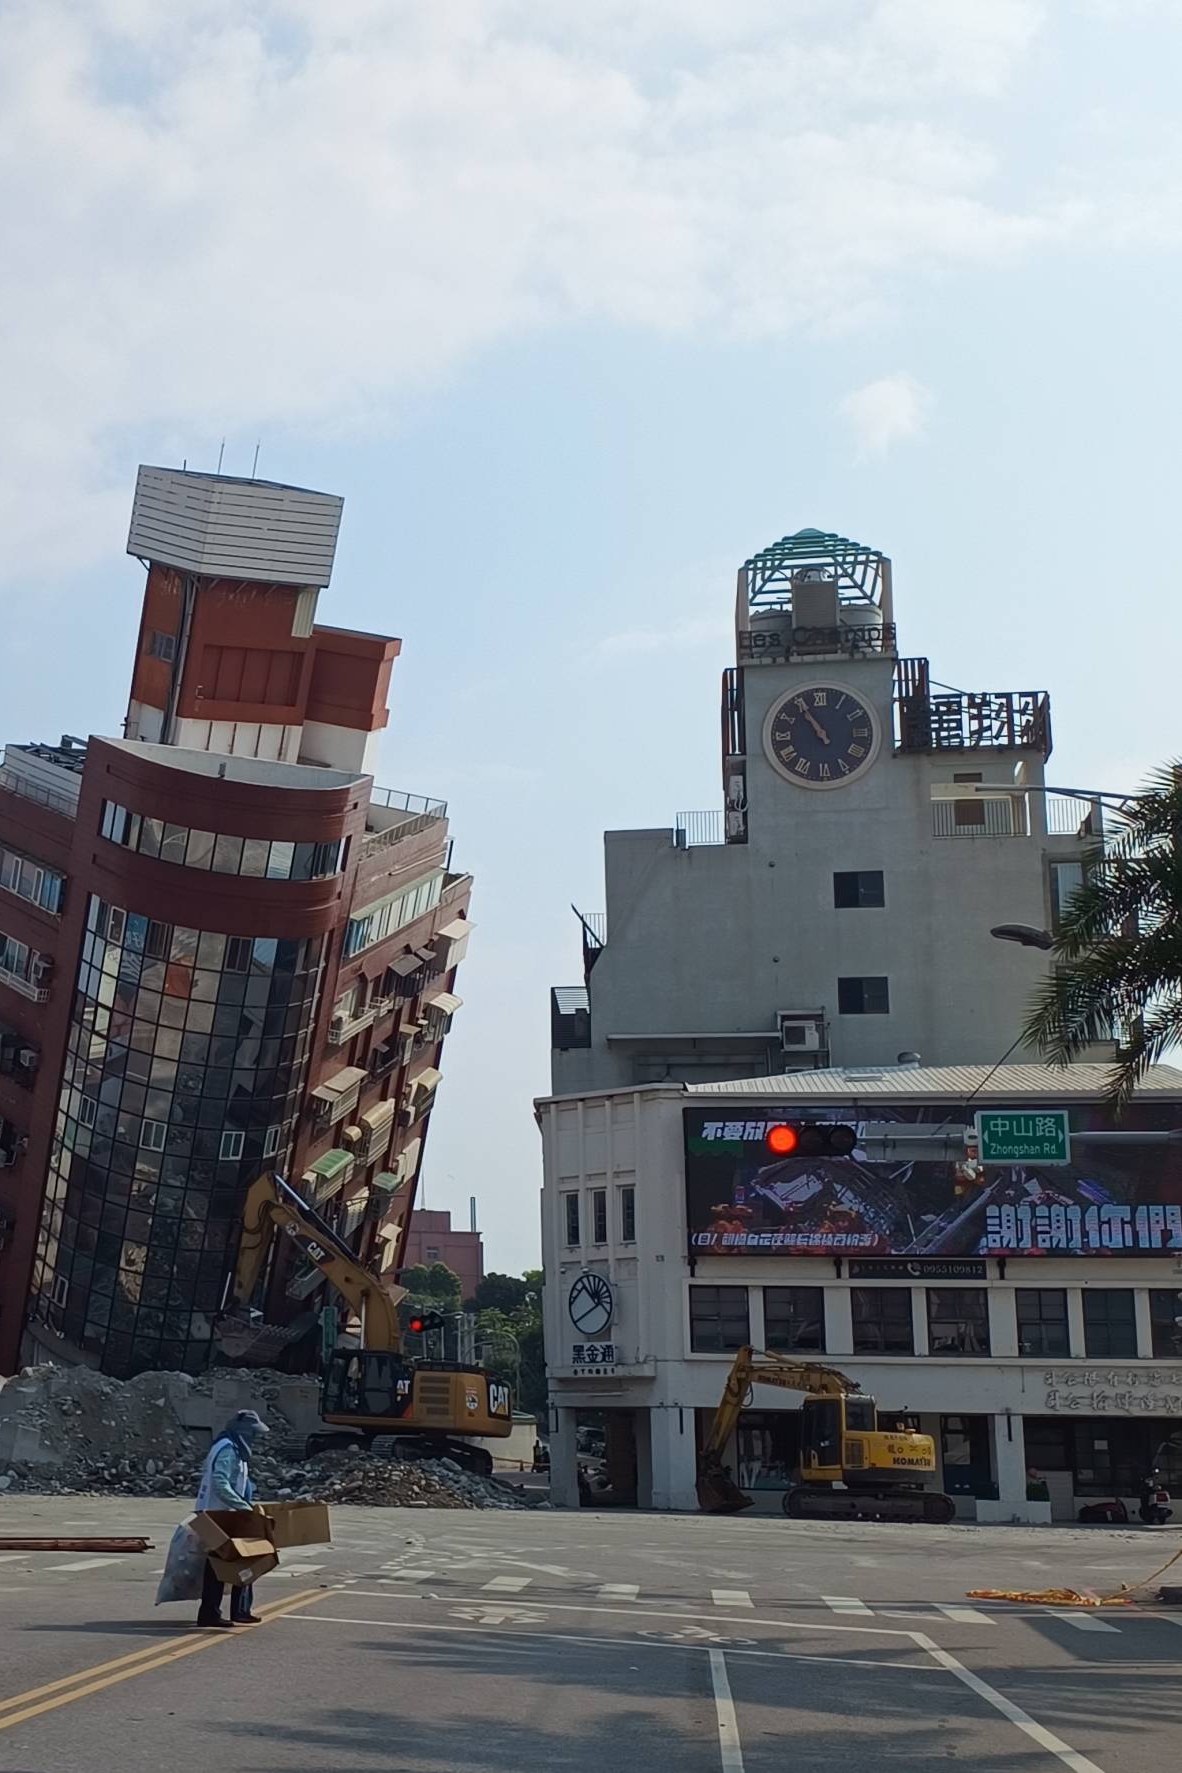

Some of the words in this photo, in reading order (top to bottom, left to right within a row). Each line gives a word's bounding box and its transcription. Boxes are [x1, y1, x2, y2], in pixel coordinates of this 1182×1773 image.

[990, 1117, 1057, 1137] 中山路
[990, 1143, 1040, 1158] Zhongshan
[1043, 1142, 1059, 1155] Rd.
[572, 1344, 615, 1364] 黑金通
[489, 1384, 509, 1417] CAT
